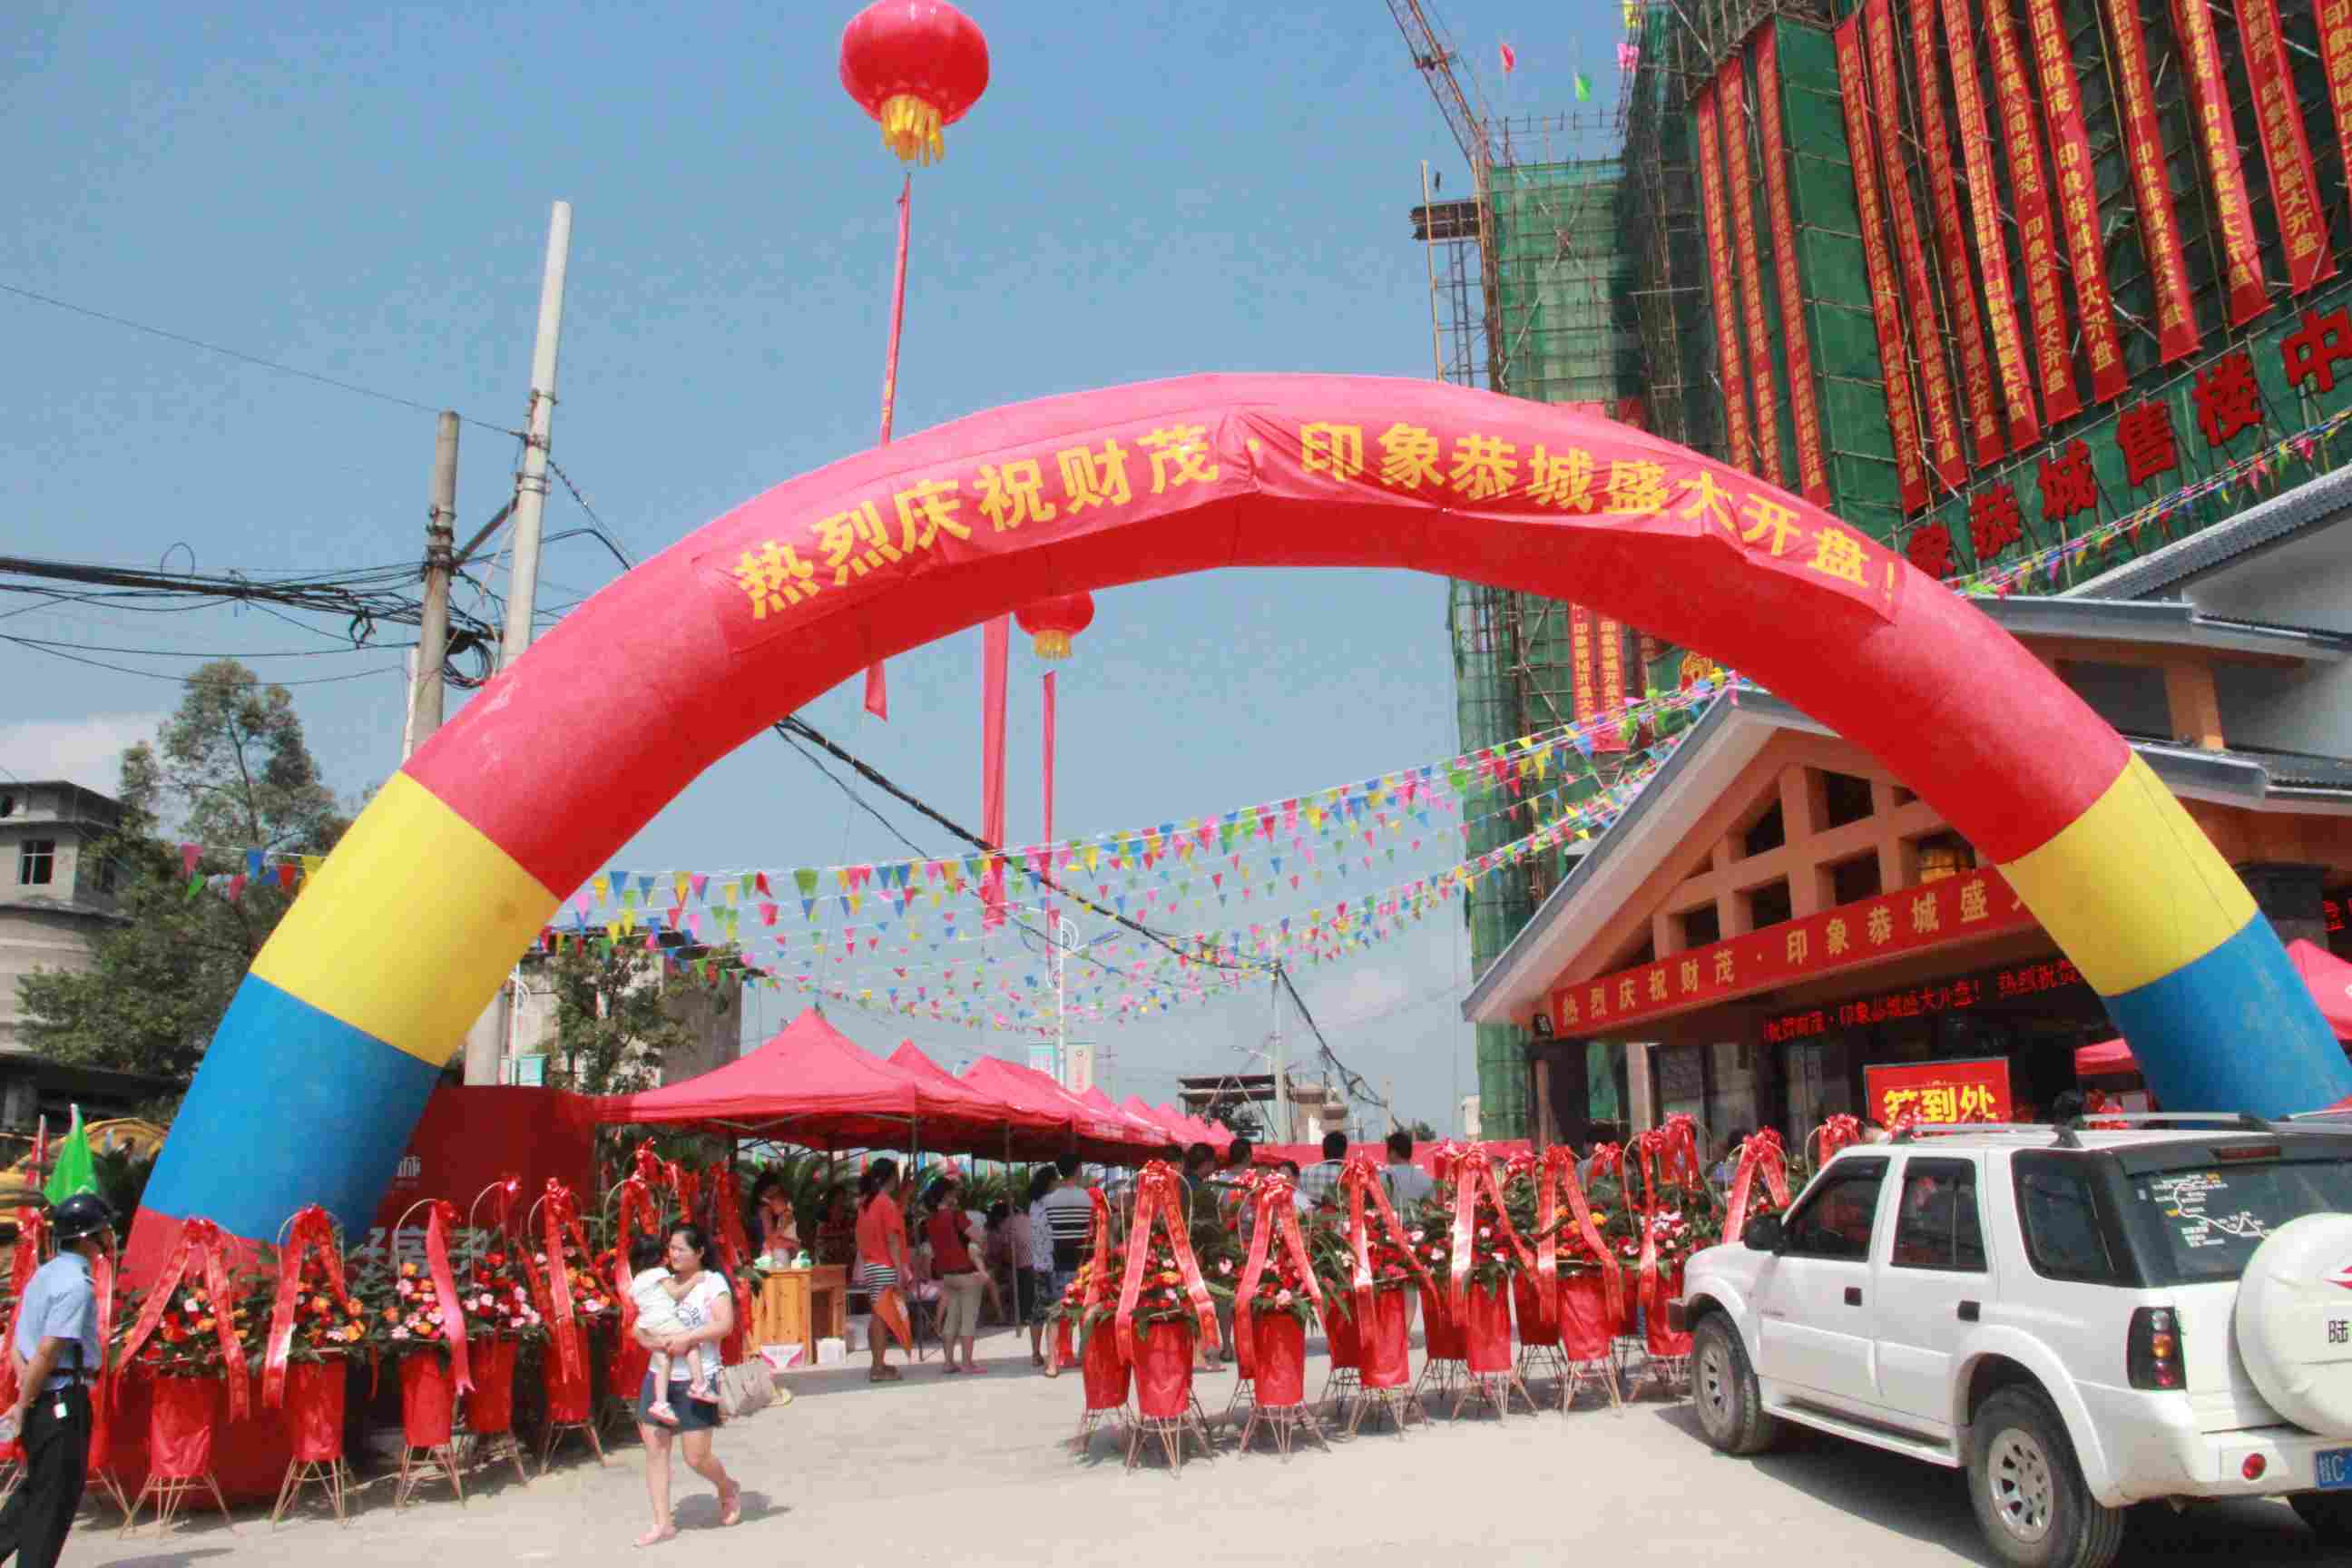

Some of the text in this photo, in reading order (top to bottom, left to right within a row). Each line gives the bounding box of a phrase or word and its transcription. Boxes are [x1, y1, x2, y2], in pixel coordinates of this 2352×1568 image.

[1562, 877, 2022, 1027] 热烈庆祝财茂·印象恭城盛
